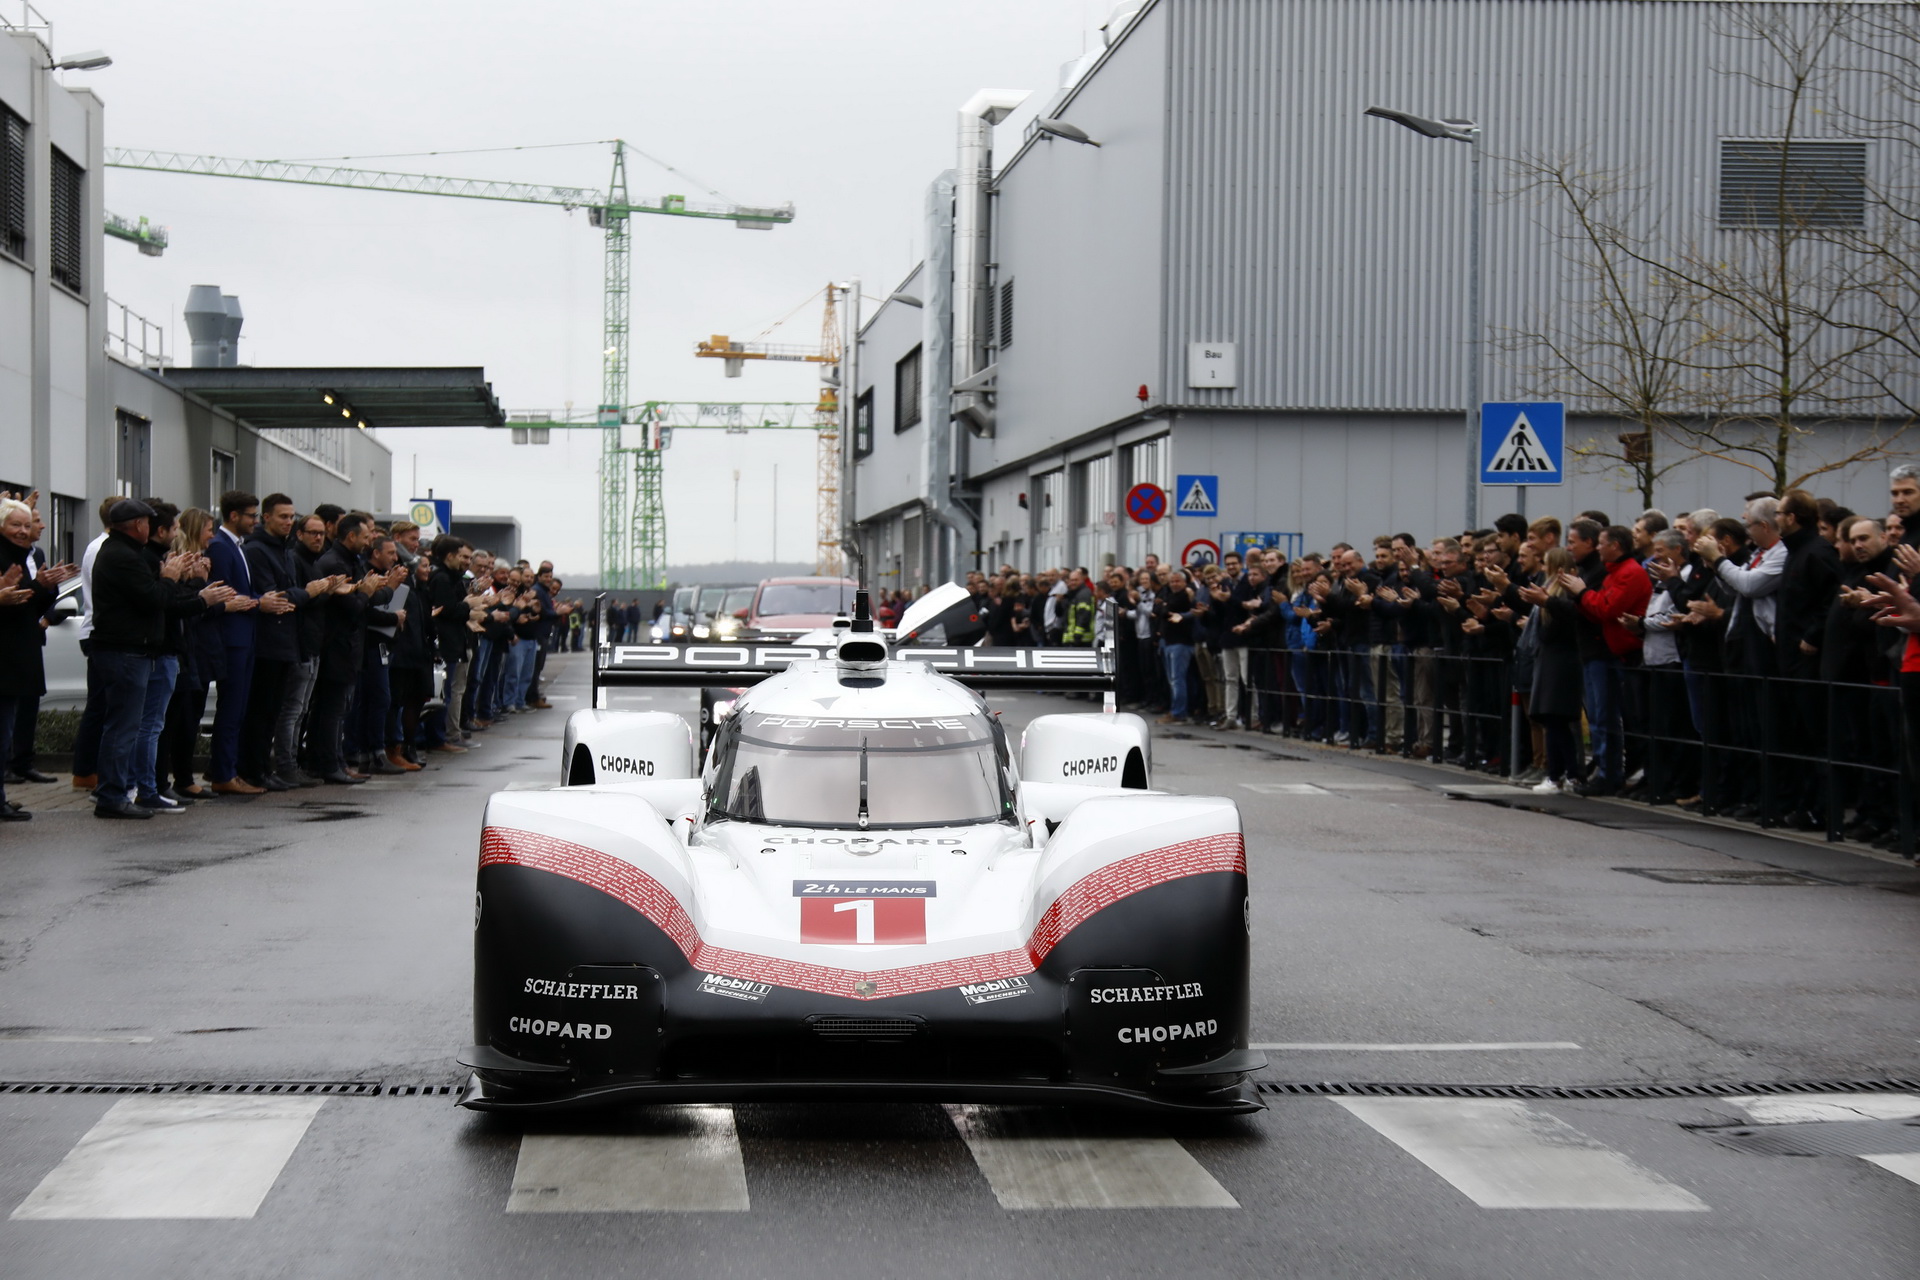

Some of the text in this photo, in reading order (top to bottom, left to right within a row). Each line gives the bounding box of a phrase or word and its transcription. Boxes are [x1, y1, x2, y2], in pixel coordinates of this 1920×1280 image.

[1205, 350, 1223, 359] Bau
[1211, 370, 1216, 379] 1
[613, 646, 1098, 669] PORCHE
[757, 717, 967, 730] PORSCHE
[600, 754, 655, 776] CHOPARD
[1062, 755, 1118, 777] CHOPARD
[763, 837, 963, 846] CHOPARD
[833, 899, 875, 944] 1
[523, 977, 639, 1000] SCHAEFFLER
[702, 973, 755, 991] Mobil
[958, 979, 1010, 996] Mobil
[716, 989, 759, 1001] MICHELIN
[986, 989, 1027, 1000] MICHELIN
[1090, 982, 1203, 1004] SCHAEFFLER
[509, 1016, 612, 1040] CHOPARD
[1117, 1018, 1218, 1044] CHOPARD
